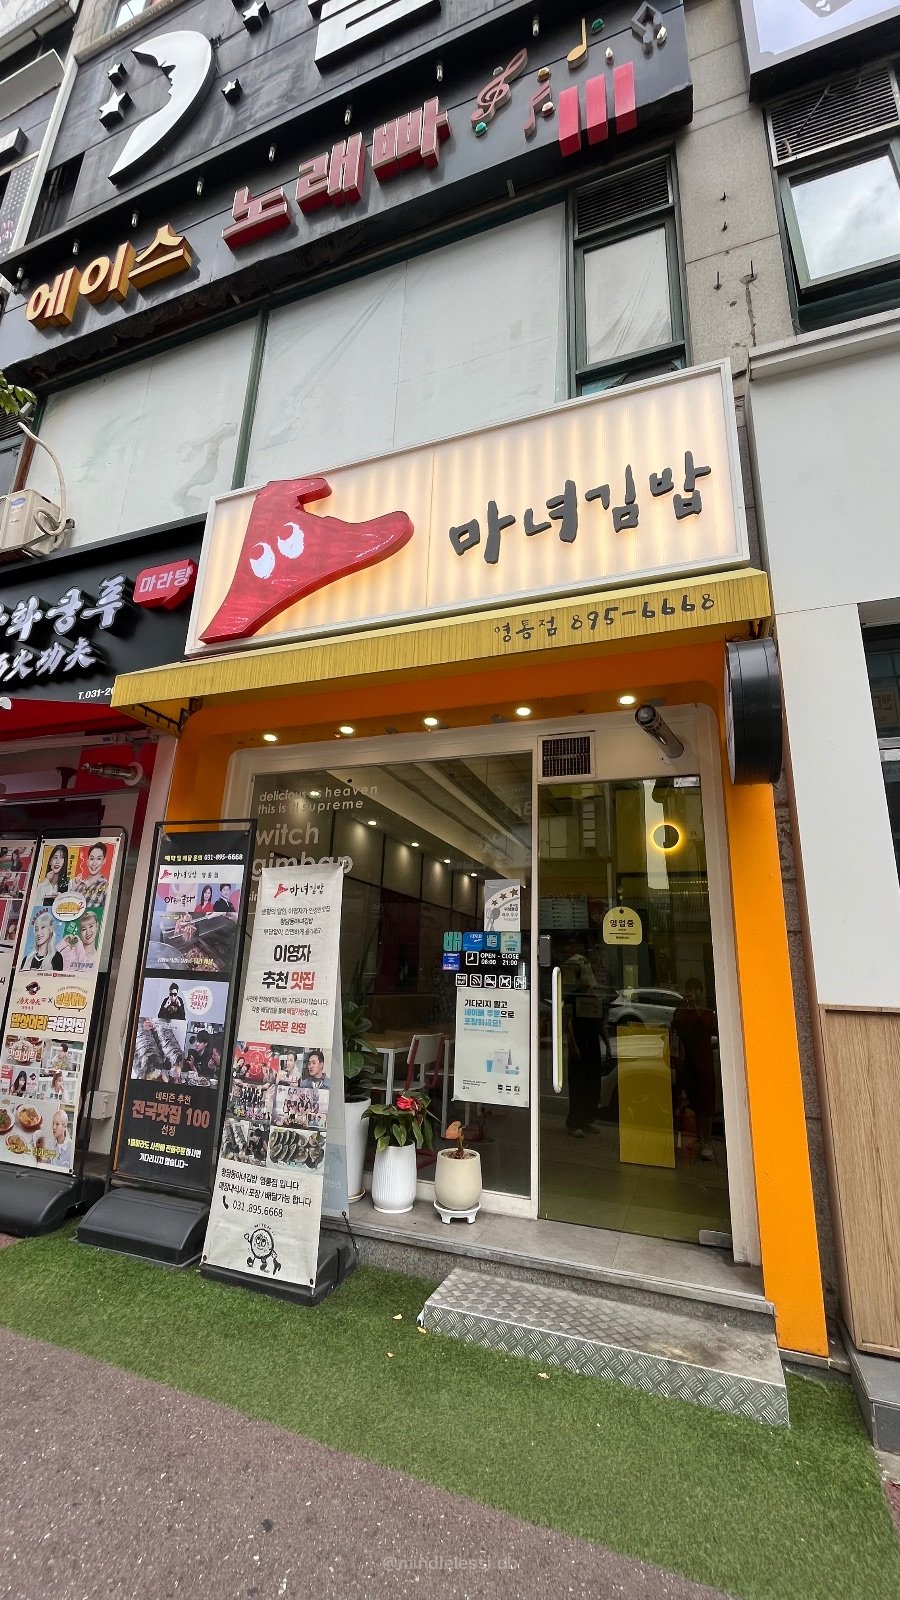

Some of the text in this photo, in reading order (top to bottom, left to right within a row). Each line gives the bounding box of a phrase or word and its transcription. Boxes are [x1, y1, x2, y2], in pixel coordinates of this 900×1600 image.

[24, 97, 451, 331] 에이스 노래빠
[449, 451, 712, 564] 마녀김밥
[140, 566, 193, 593] 마라탕
[494, 594, 714, 642] 영통점 895-6668
[260, 790, 306, 802] delicious
[325, 786, 378, 797] heaven
[259, 803, 275, 814] this
[279, 803, 286, 813] is
[256, 822, 319, 846] witch
[290, 882, 324, 896] 마녀김밥
[610, 919, 634, 928] 영업중
[273, 944, 311, 962] 이영자
[262, 970, 316, 990] 추천 맛집
[464, 999, 508, 1009] 기다리지 말고
[486, 1009, 515, 1019] 주문으로
[260, 1020, 307, 1034] 단체주문 환영
[156, 1091, 192, 1105] 네티즌 추천
[131, 1100, 210, 1129] 전국맛집 100
[161, 1124, 176, 1137] 선정
[259, 1176, 278, 1187] 영통점
[279, 1179, 300, 1190] 입니다
[292, 1195, 312, 1208] 합니다
